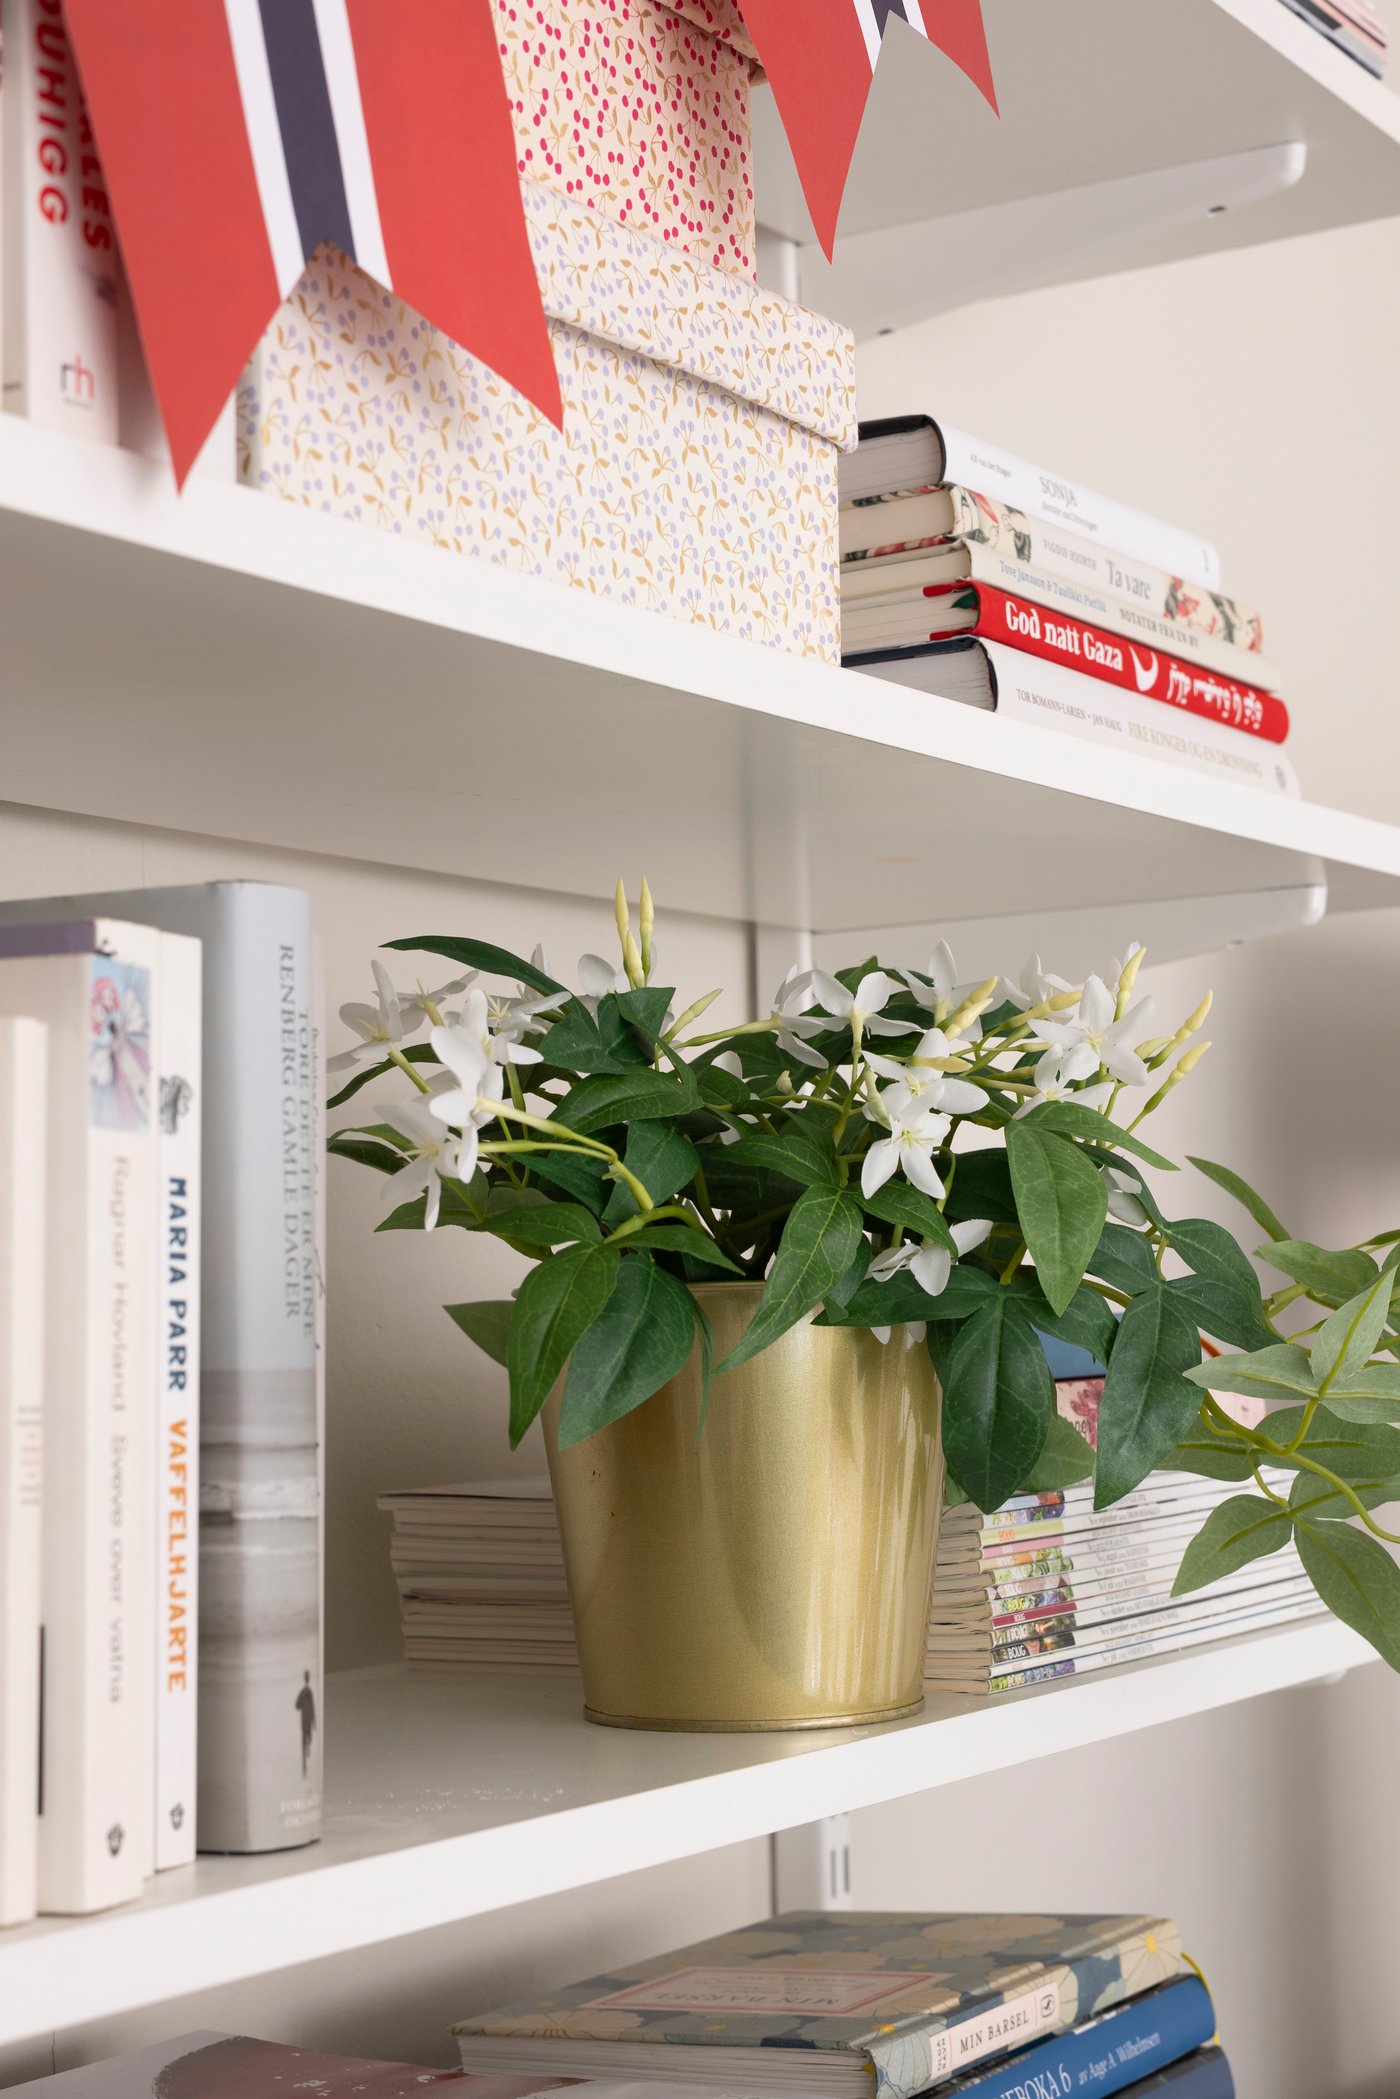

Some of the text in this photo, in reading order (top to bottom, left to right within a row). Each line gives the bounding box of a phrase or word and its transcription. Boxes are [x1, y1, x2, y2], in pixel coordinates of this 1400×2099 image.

[1039, 476, 1077, 508] SONJA
[999, 560, 1017, 578] Tove
[1017, 566, 1047, 588] Jansson
[1105, 558, 1151, 599] Ta vare
[1005, 600, 1124, 672] God natt Gaza
[1120, 608, 1157, 632] NOTATER
[1159, 620, 1175, 640] FRA
[1016, 688, 1031, 703] TOR
[1031, 692, 1086, 720] BOMANN-LARSEN
[280, 945, 300, 1318] RENBERG GAMLE DAGER
[303, 1256, 315, 1338] MINE
[109, 1155, 130, 1704] Ragnar Hovland Sveve over vatna
[168, 1177, 187, 1693] MARIA PARR VAFFELHJARTE
[960, 2010, 1030, 2054] MIN BARSEL
[1059, 2063, 1072, 2093] 6
